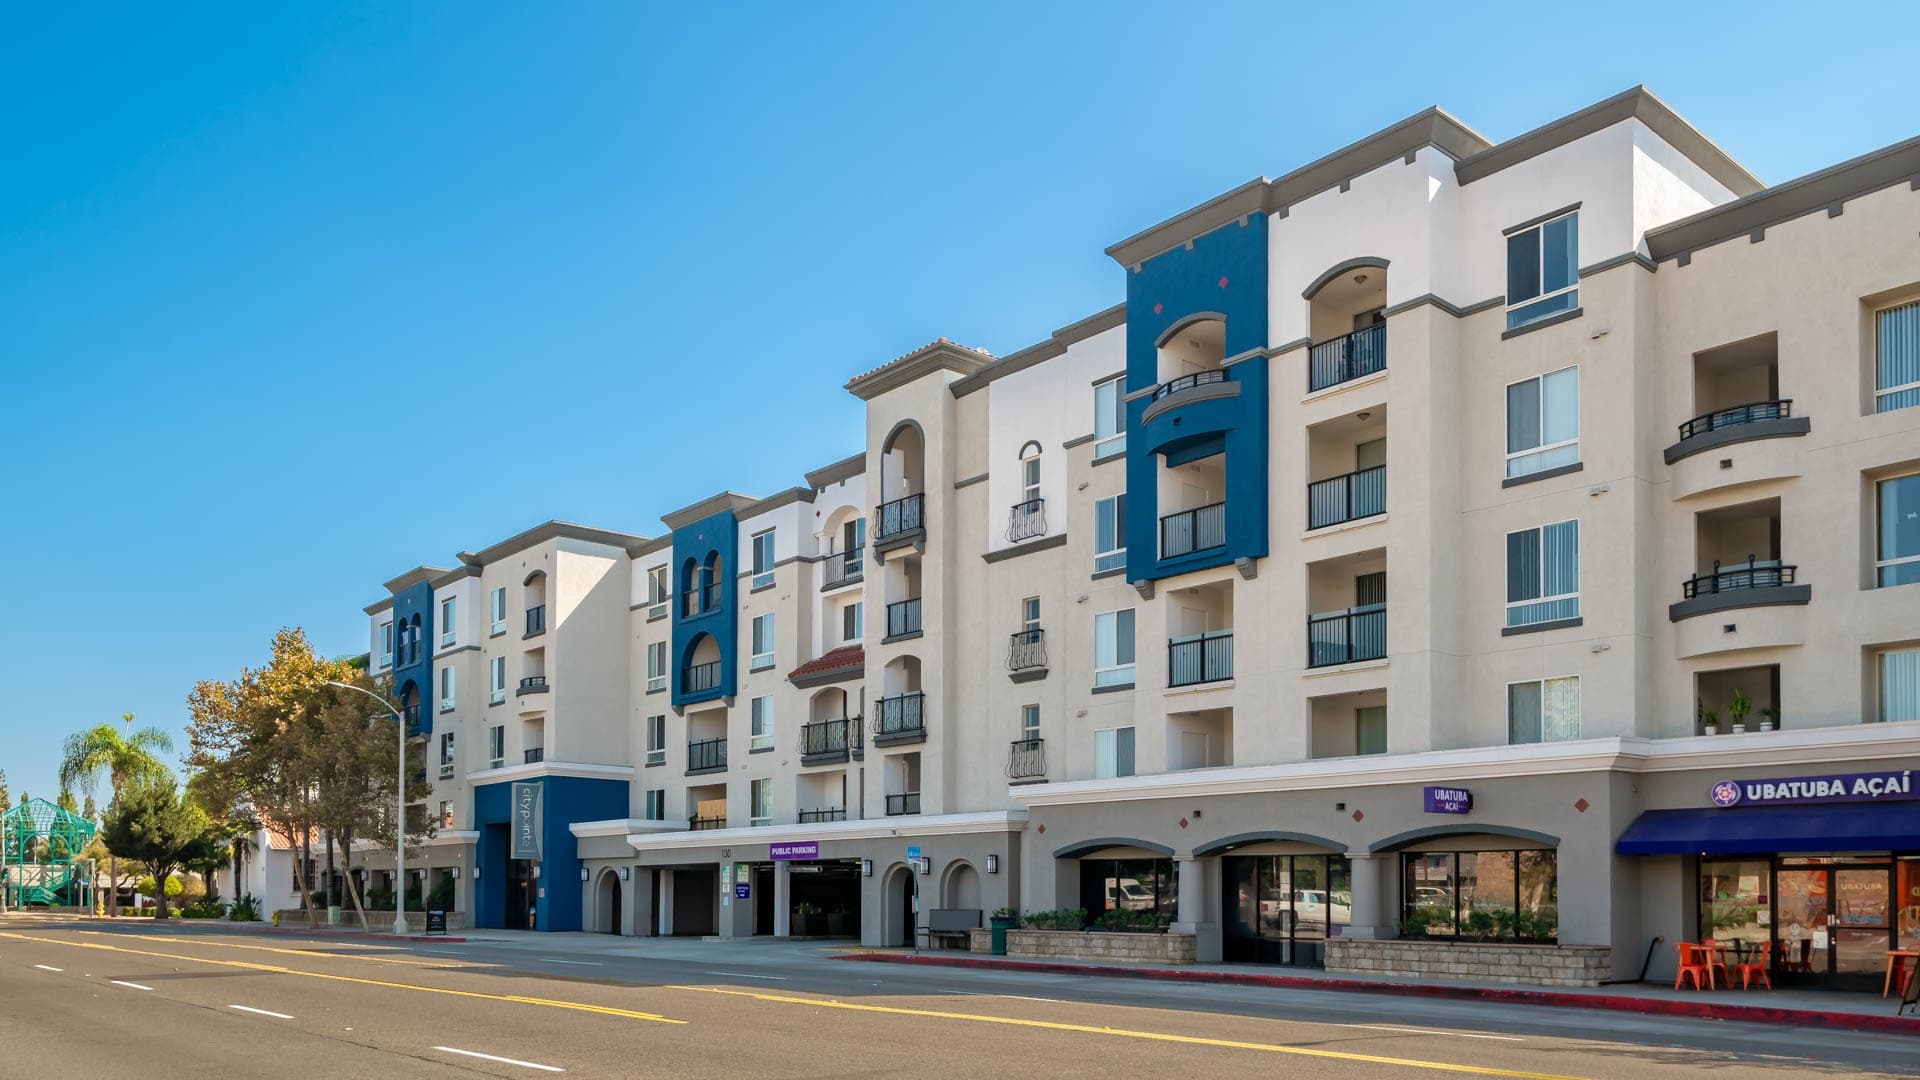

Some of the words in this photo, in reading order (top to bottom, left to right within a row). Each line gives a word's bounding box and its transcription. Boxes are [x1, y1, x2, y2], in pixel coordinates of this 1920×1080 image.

[1747, 779, 1846, 800] UBATUBA
[1852, 770, 1911, 797] AÇAÍ
[1434, 788, 1468, 801] UBATUBA
[771, 847, 791, 855] PUBLIC
[792, 846, 817, 854] PARKING
